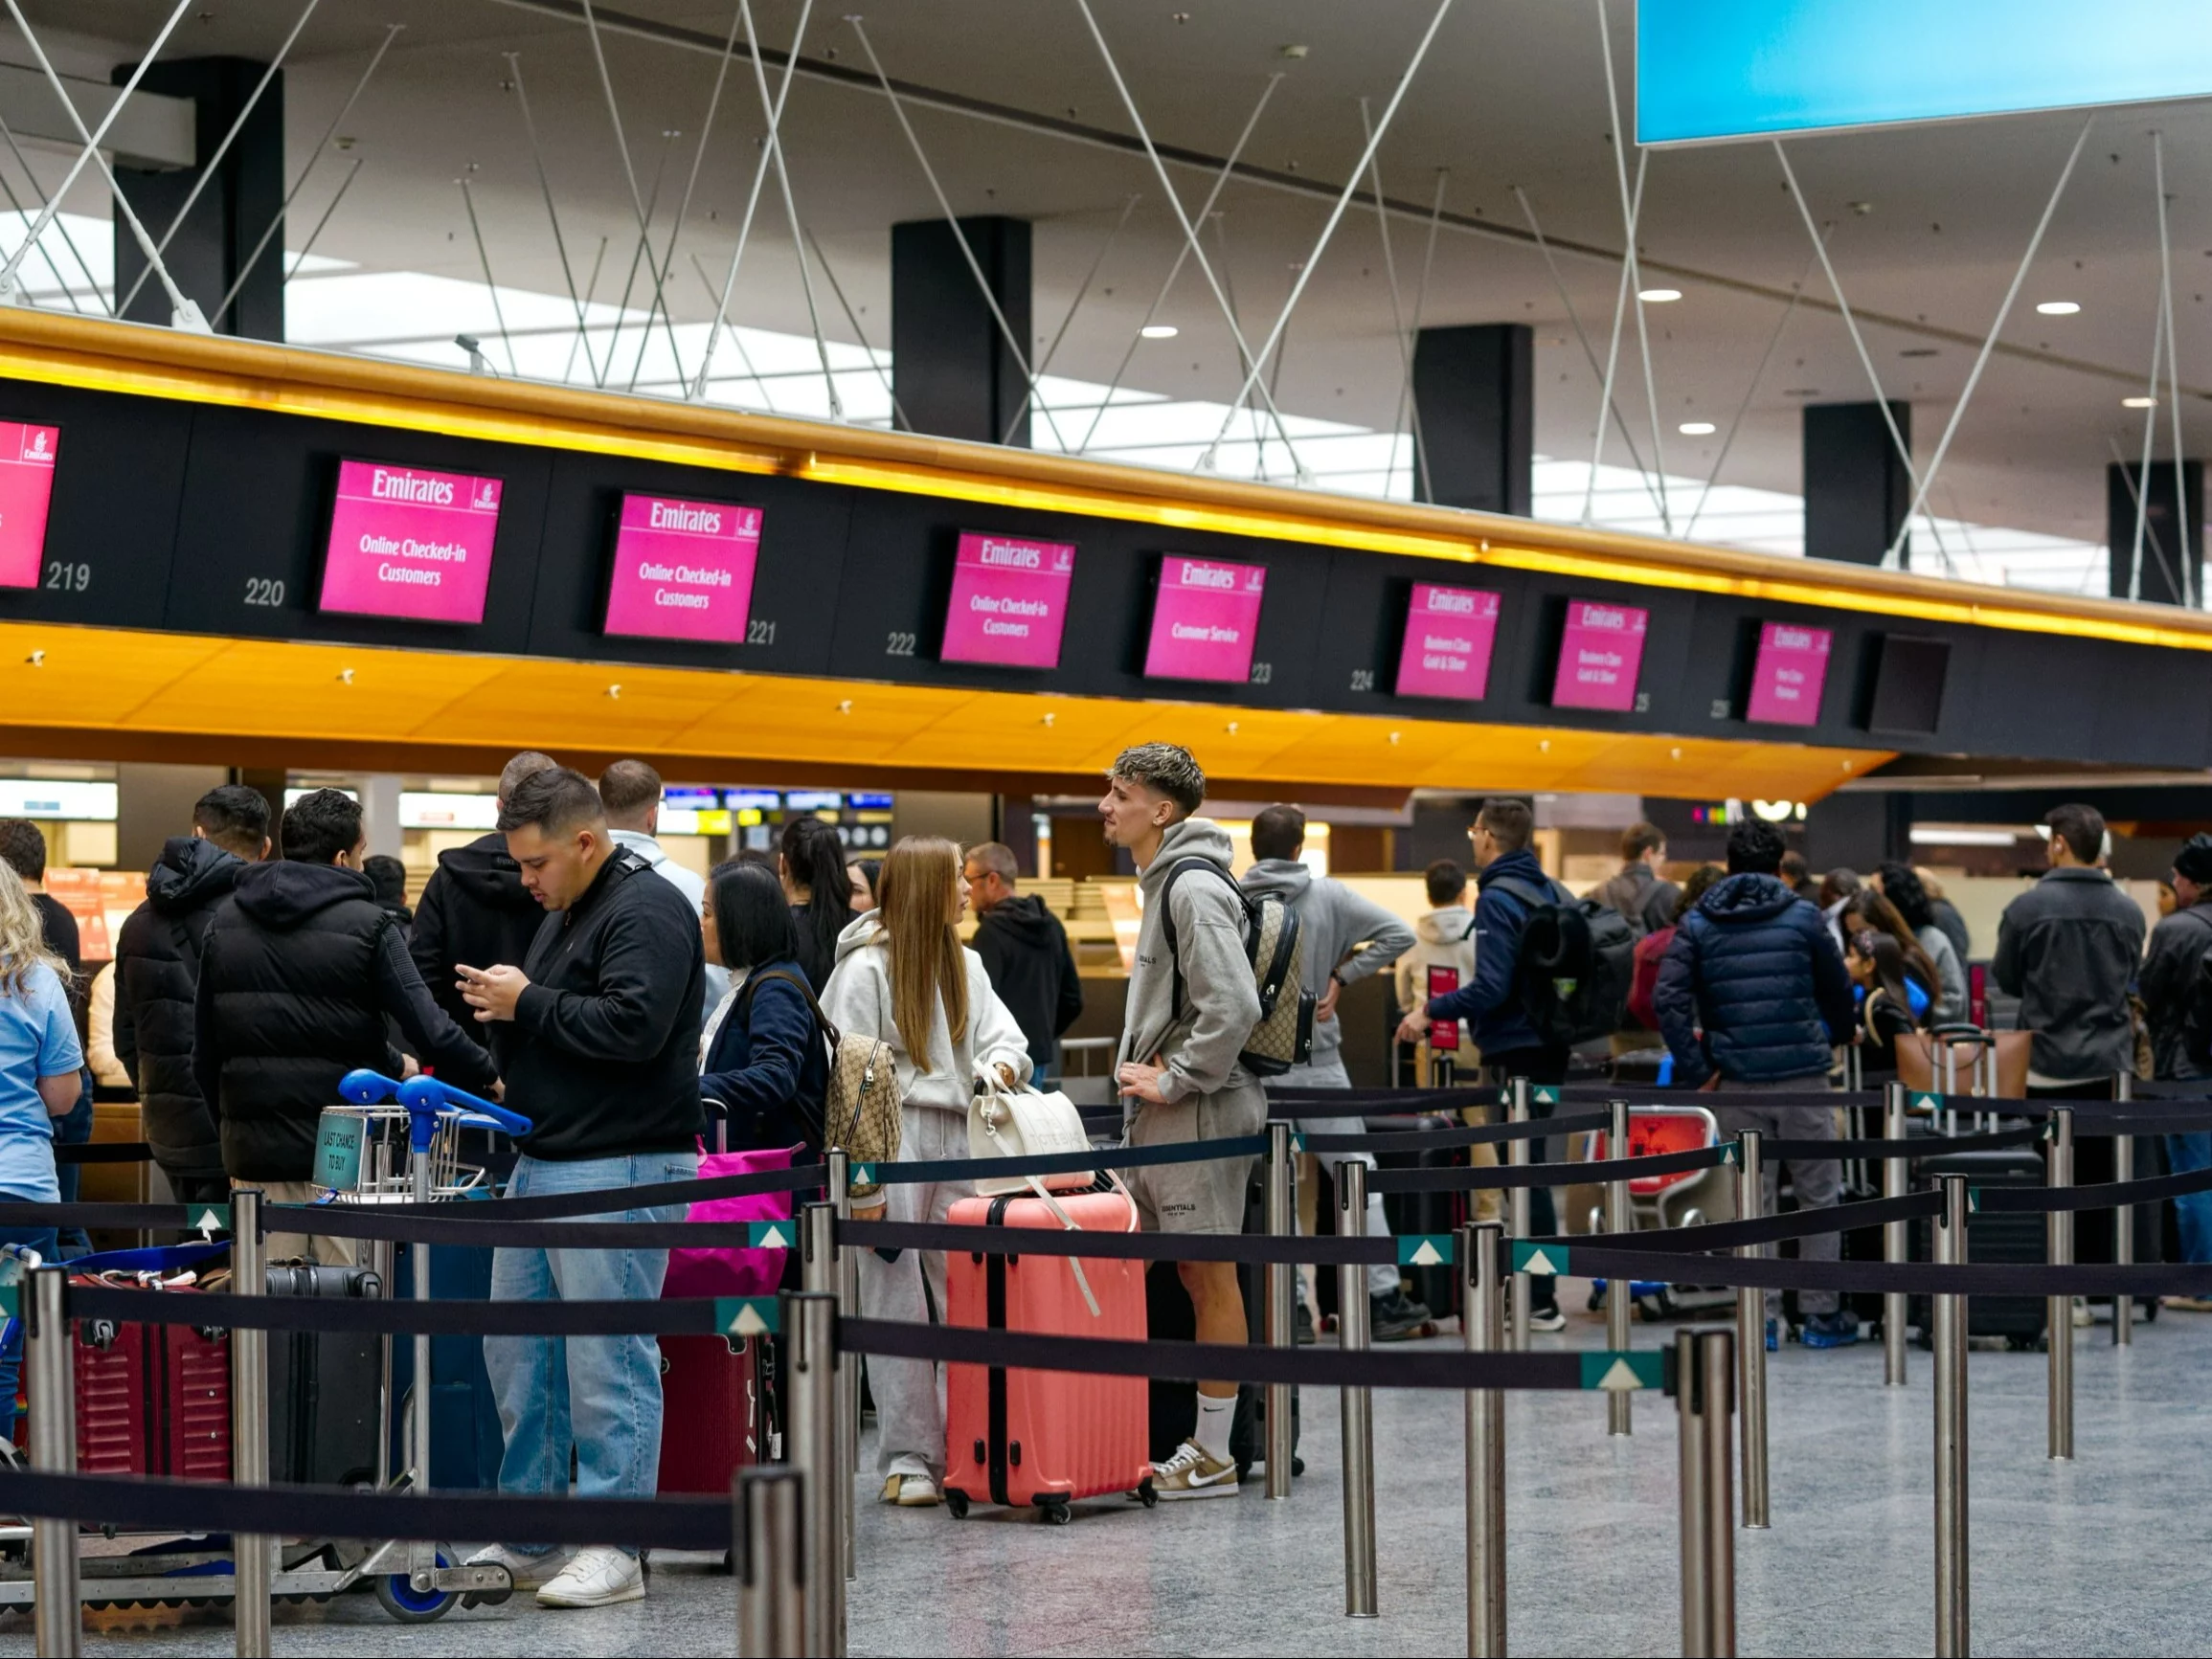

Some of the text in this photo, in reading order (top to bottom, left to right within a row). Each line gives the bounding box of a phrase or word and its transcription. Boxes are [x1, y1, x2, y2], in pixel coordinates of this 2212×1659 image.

[372, 468, 455, 504] Emirates
[650, 501, 721, 533] Emirates
[360, 534, 467, 563] Online Checked-in
[982, 539, 1040, 568] Emirates
[46, 561, 90, 592] 219
[378, 562, 441, 587] Customers
[639, 562, 732, 587] Online Checked-in
[1182, 562, 1235, 588] Emirates
[244, 576, 285, 608] 220
[654, 588, 710, 610] Customers
[747, 619, 777, 645] 221
[886, 632, 916, 656] 222
[324, 1132, 354, 1150] LAST CHANCE
[328, 1155, 346, 1171] TO BUY
